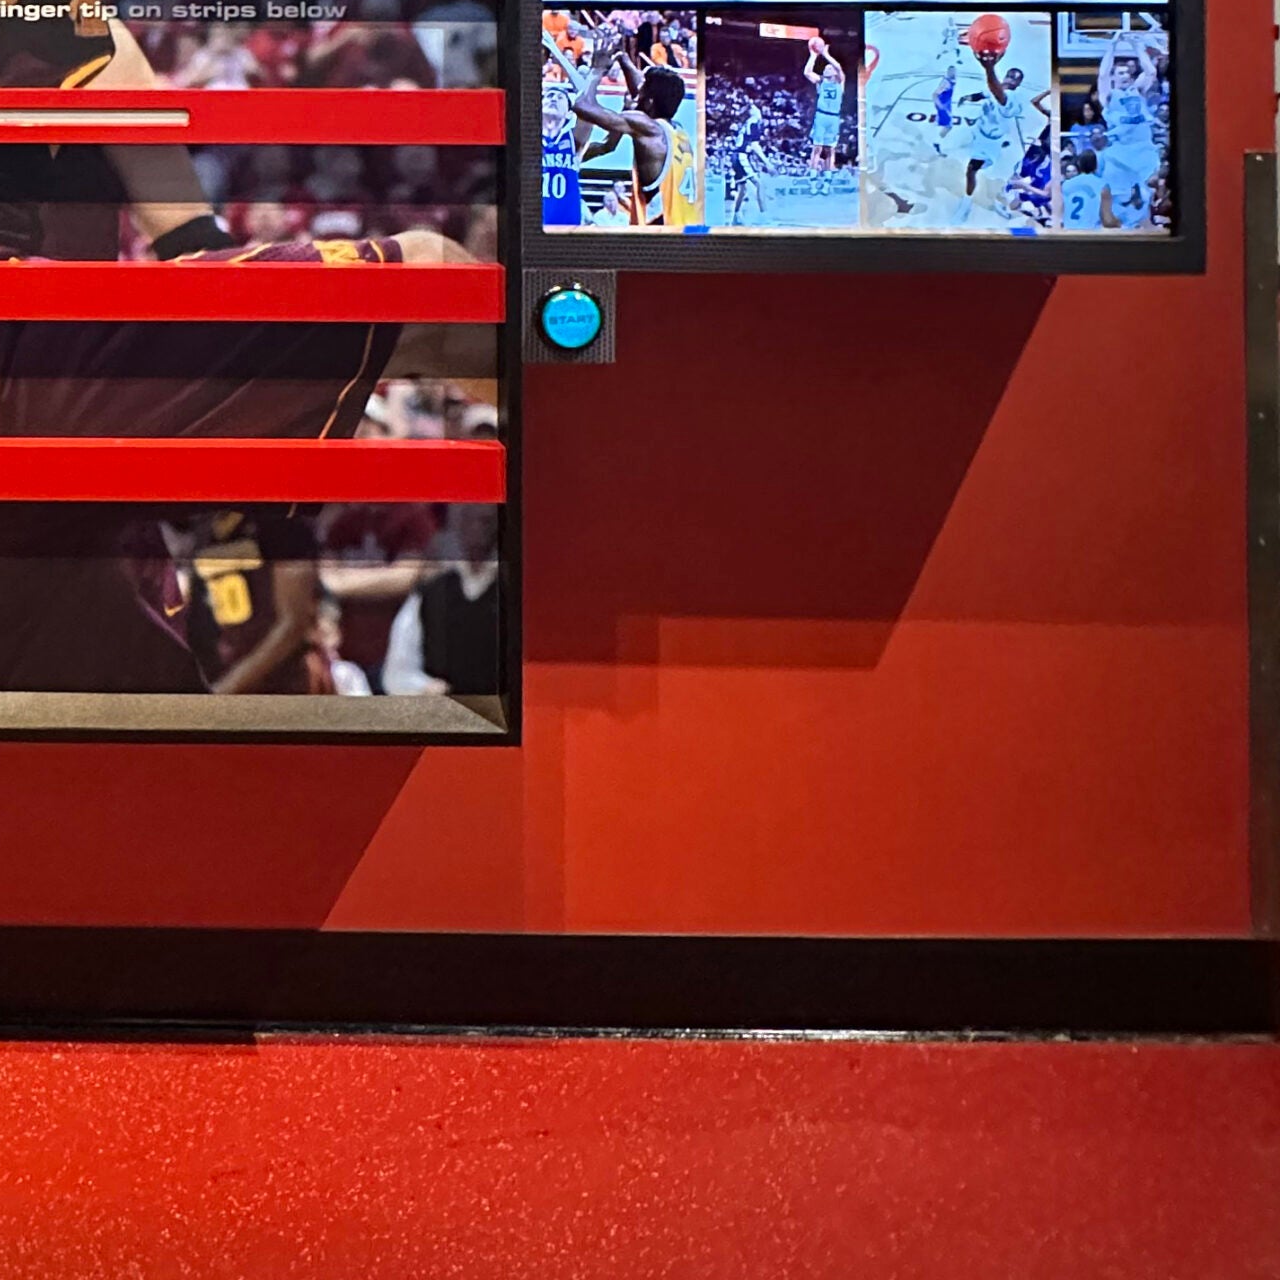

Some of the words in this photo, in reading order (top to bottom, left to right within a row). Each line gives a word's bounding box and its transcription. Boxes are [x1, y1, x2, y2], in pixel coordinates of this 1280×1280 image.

[79, 0, 119, 20] tip
[127, 3, 162, 18] on
[170, 0, 258, 20] strips
[265, 0, 349, 19] below
[542, 171, 567, 199] 10
[1069, 195, 1085, 220] 2
